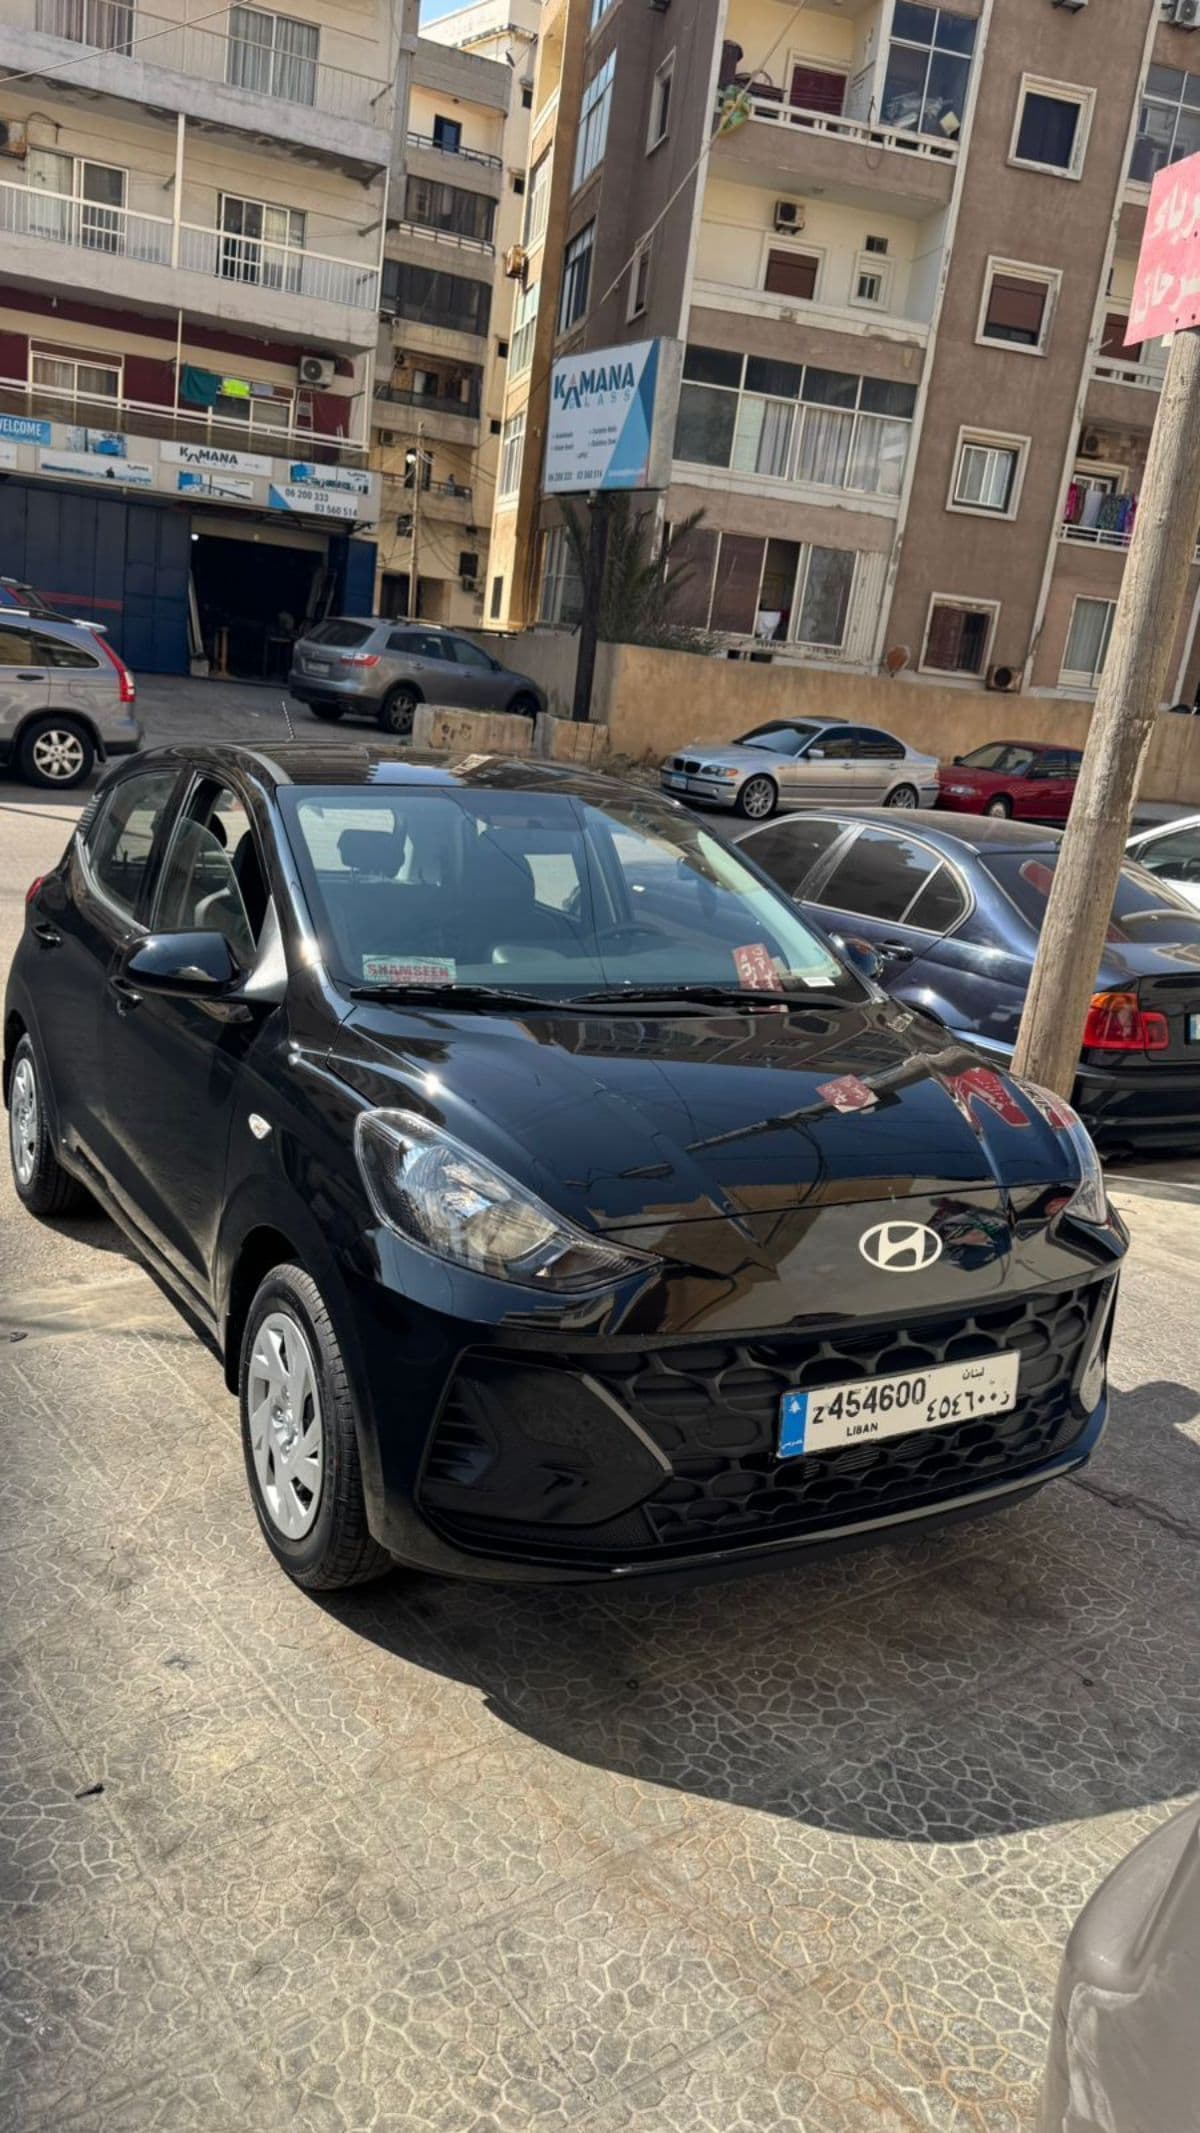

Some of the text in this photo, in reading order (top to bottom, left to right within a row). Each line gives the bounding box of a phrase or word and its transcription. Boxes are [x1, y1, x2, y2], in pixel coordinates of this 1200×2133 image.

[554, 362, 634, 410] KAMANA
[180, 446, 238, 464] KAMANA
[297, 489, 312, 500] 200
[963, 1367, 985, 1380] لبنان
[846, 1422, 878, 1437] LIBAN
